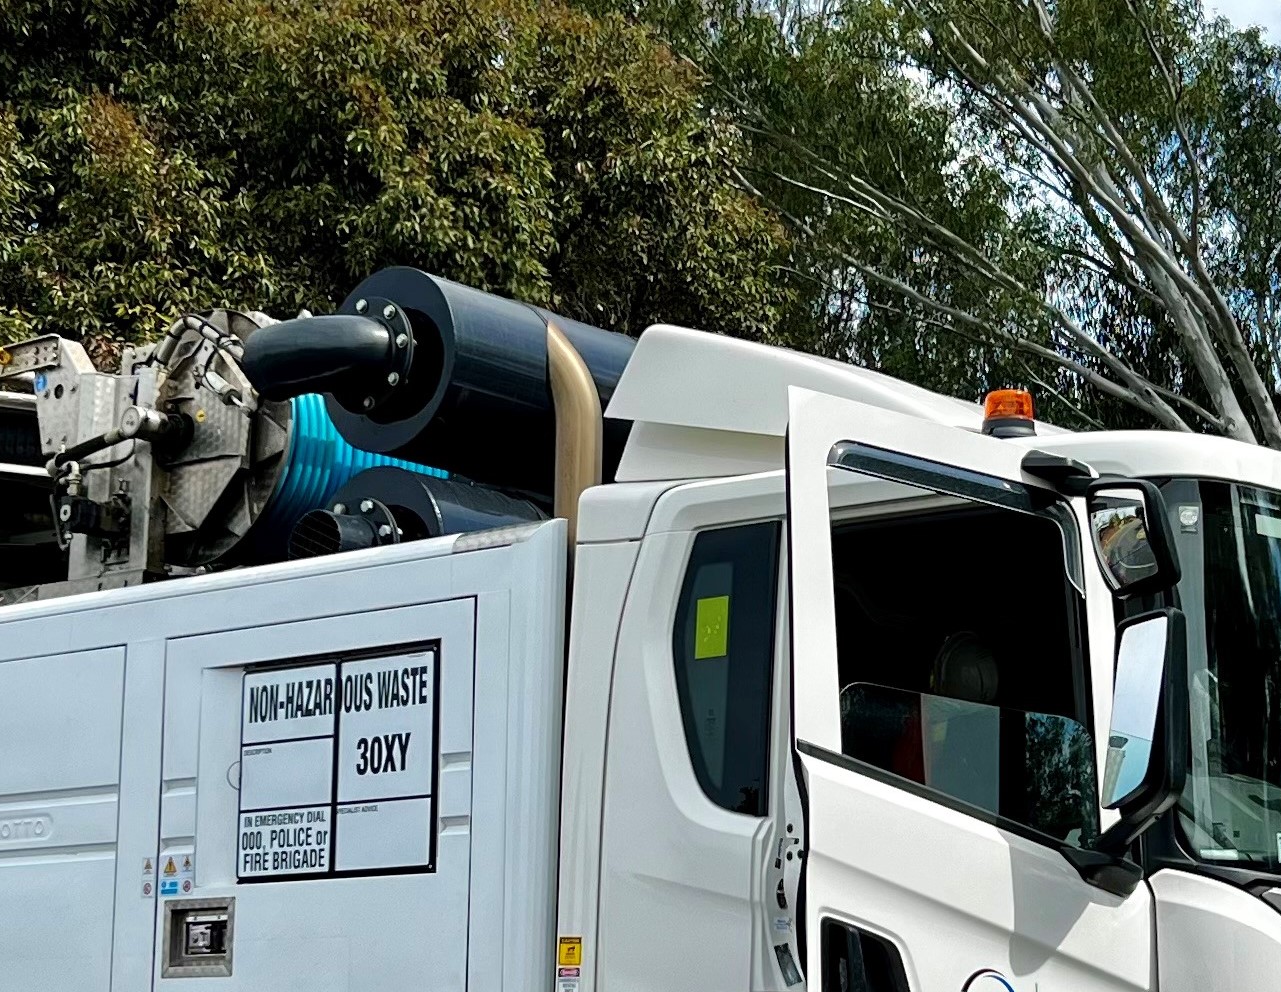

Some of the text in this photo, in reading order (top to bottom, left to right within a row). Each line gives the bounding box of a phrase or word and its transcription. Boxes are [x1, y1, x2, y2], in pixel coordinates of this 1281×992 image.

[377, 666, 428, 709] WASTE
[356, 732, 411, 776] 30XY
[244, 810, 326, 828] IN EMERGENCY DIAL
[270, 827, 313, 848] POLICE
[316, 829, 328, 845] or
[243, 848, 325, 872] FIRE BRIGADE
